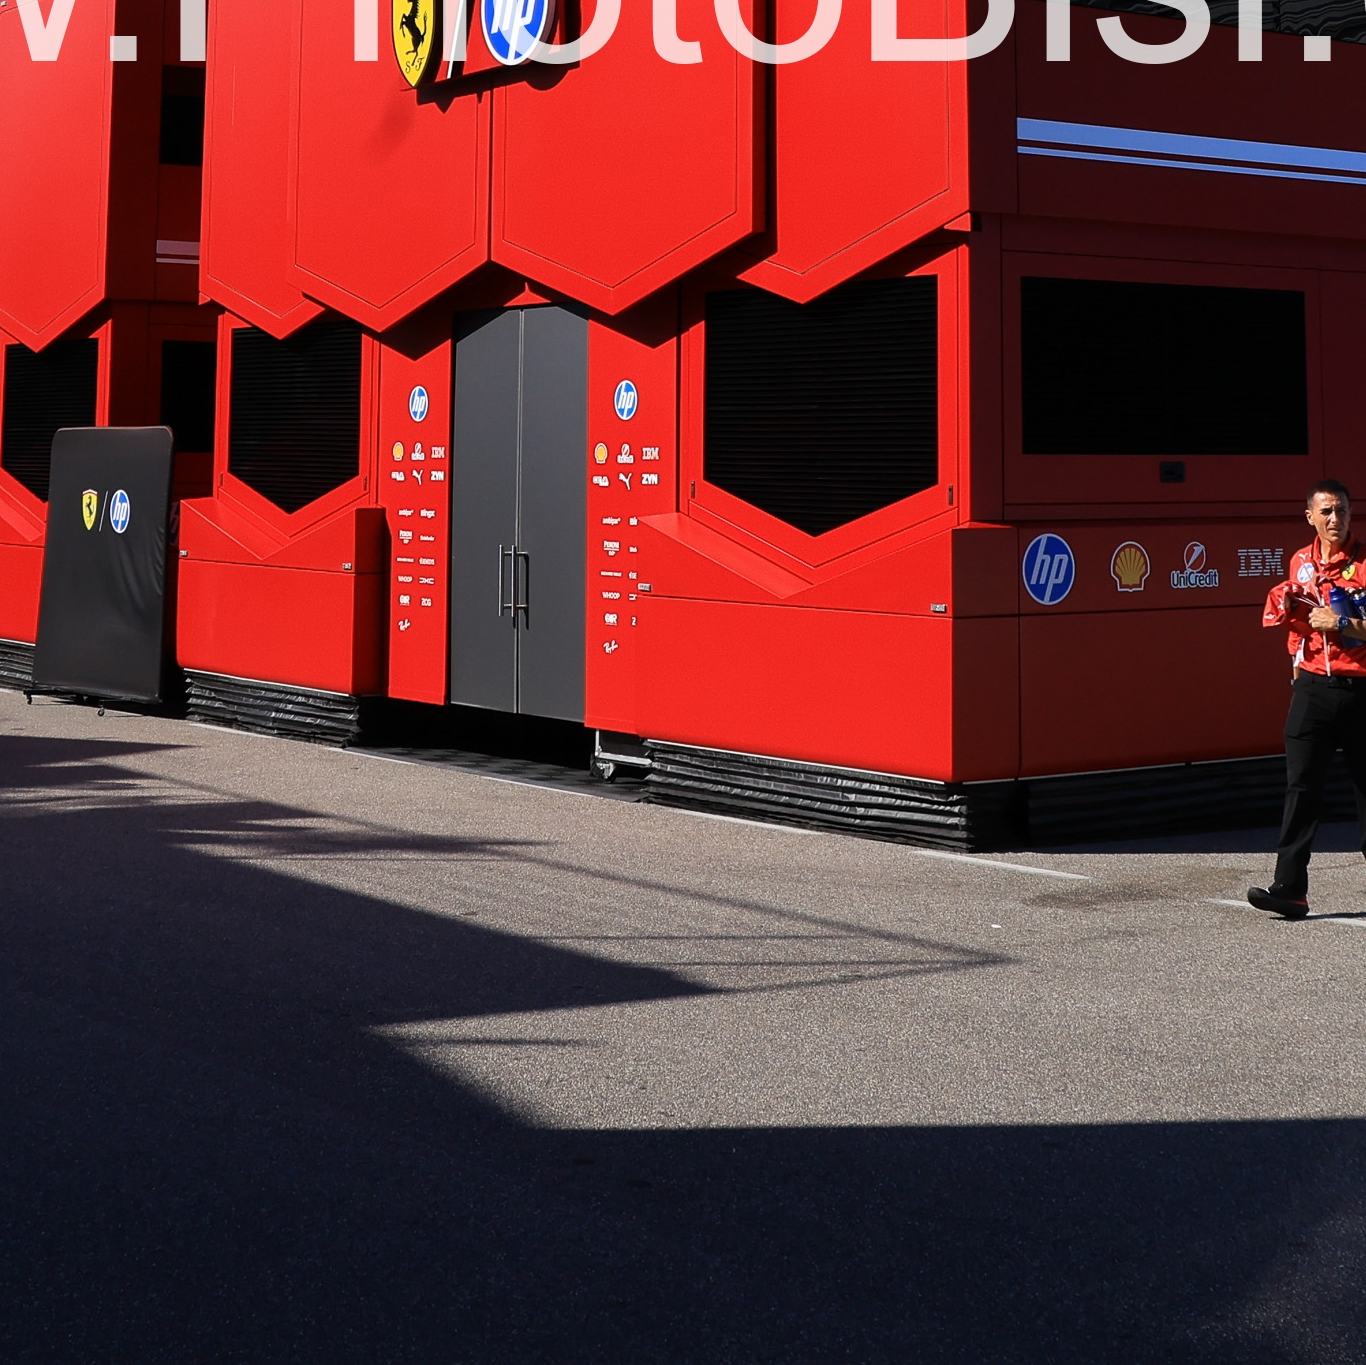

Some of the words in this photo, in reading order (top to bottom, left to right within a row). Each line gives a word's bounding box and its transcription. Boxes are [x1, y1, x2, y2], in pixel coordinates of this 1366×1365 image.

[617, 381, 635, 418] hp
[642, 447, 659, 460] IBM
[641, 473, 658, 484] ZYN
[1030, 534, 1069, 603] hp
[1237, 548, 1284, 576] IBM
[1171, 570, 1219, 588] UniCredit
